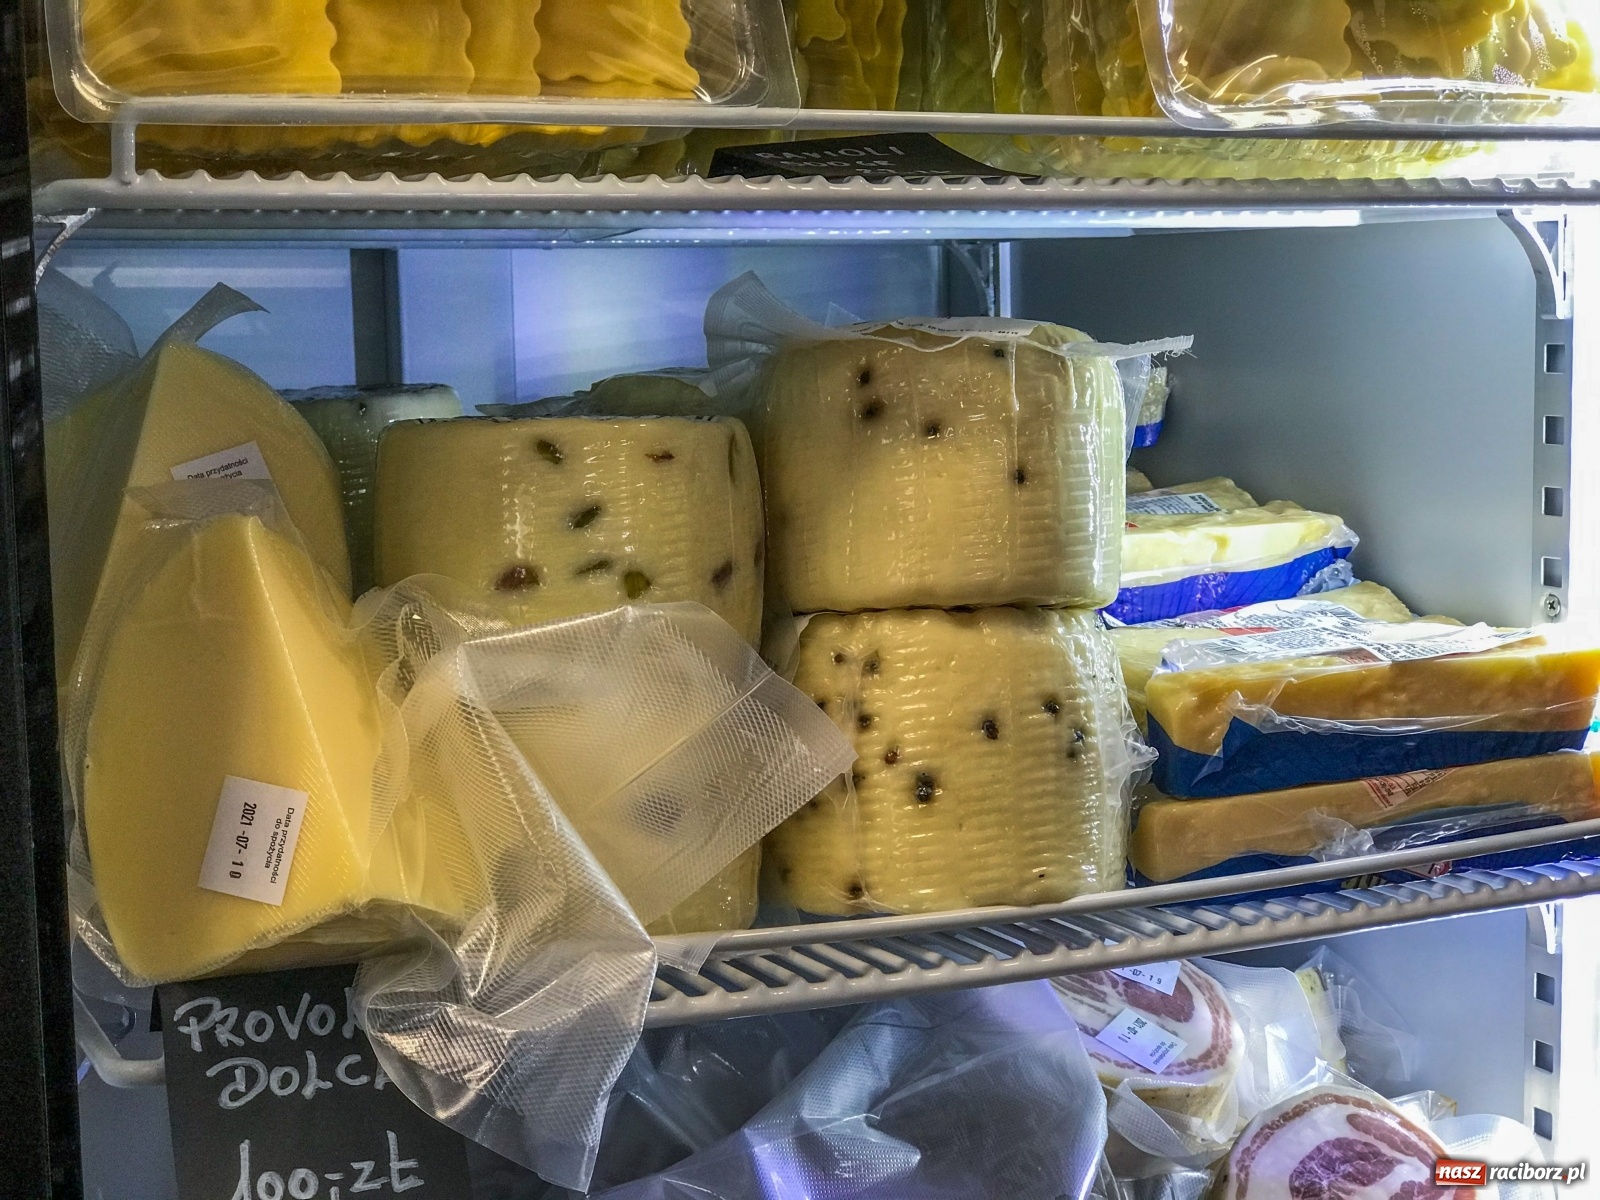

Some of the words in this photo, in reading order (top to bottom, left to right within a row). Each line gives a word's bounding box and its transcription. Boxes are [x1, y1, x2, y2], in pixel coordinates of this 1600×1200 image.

[755, 146, 905, 160] RAVIOLI
[206, 457, 249, 478] przydatności
[274, 818, 282, 829] do
[283, 807, 295, 828] Data
[264, 831, 279, 869] spożycia
[270, 829, 288, 884] przydatności
[173, 986, 365, 1052] PROVOL
